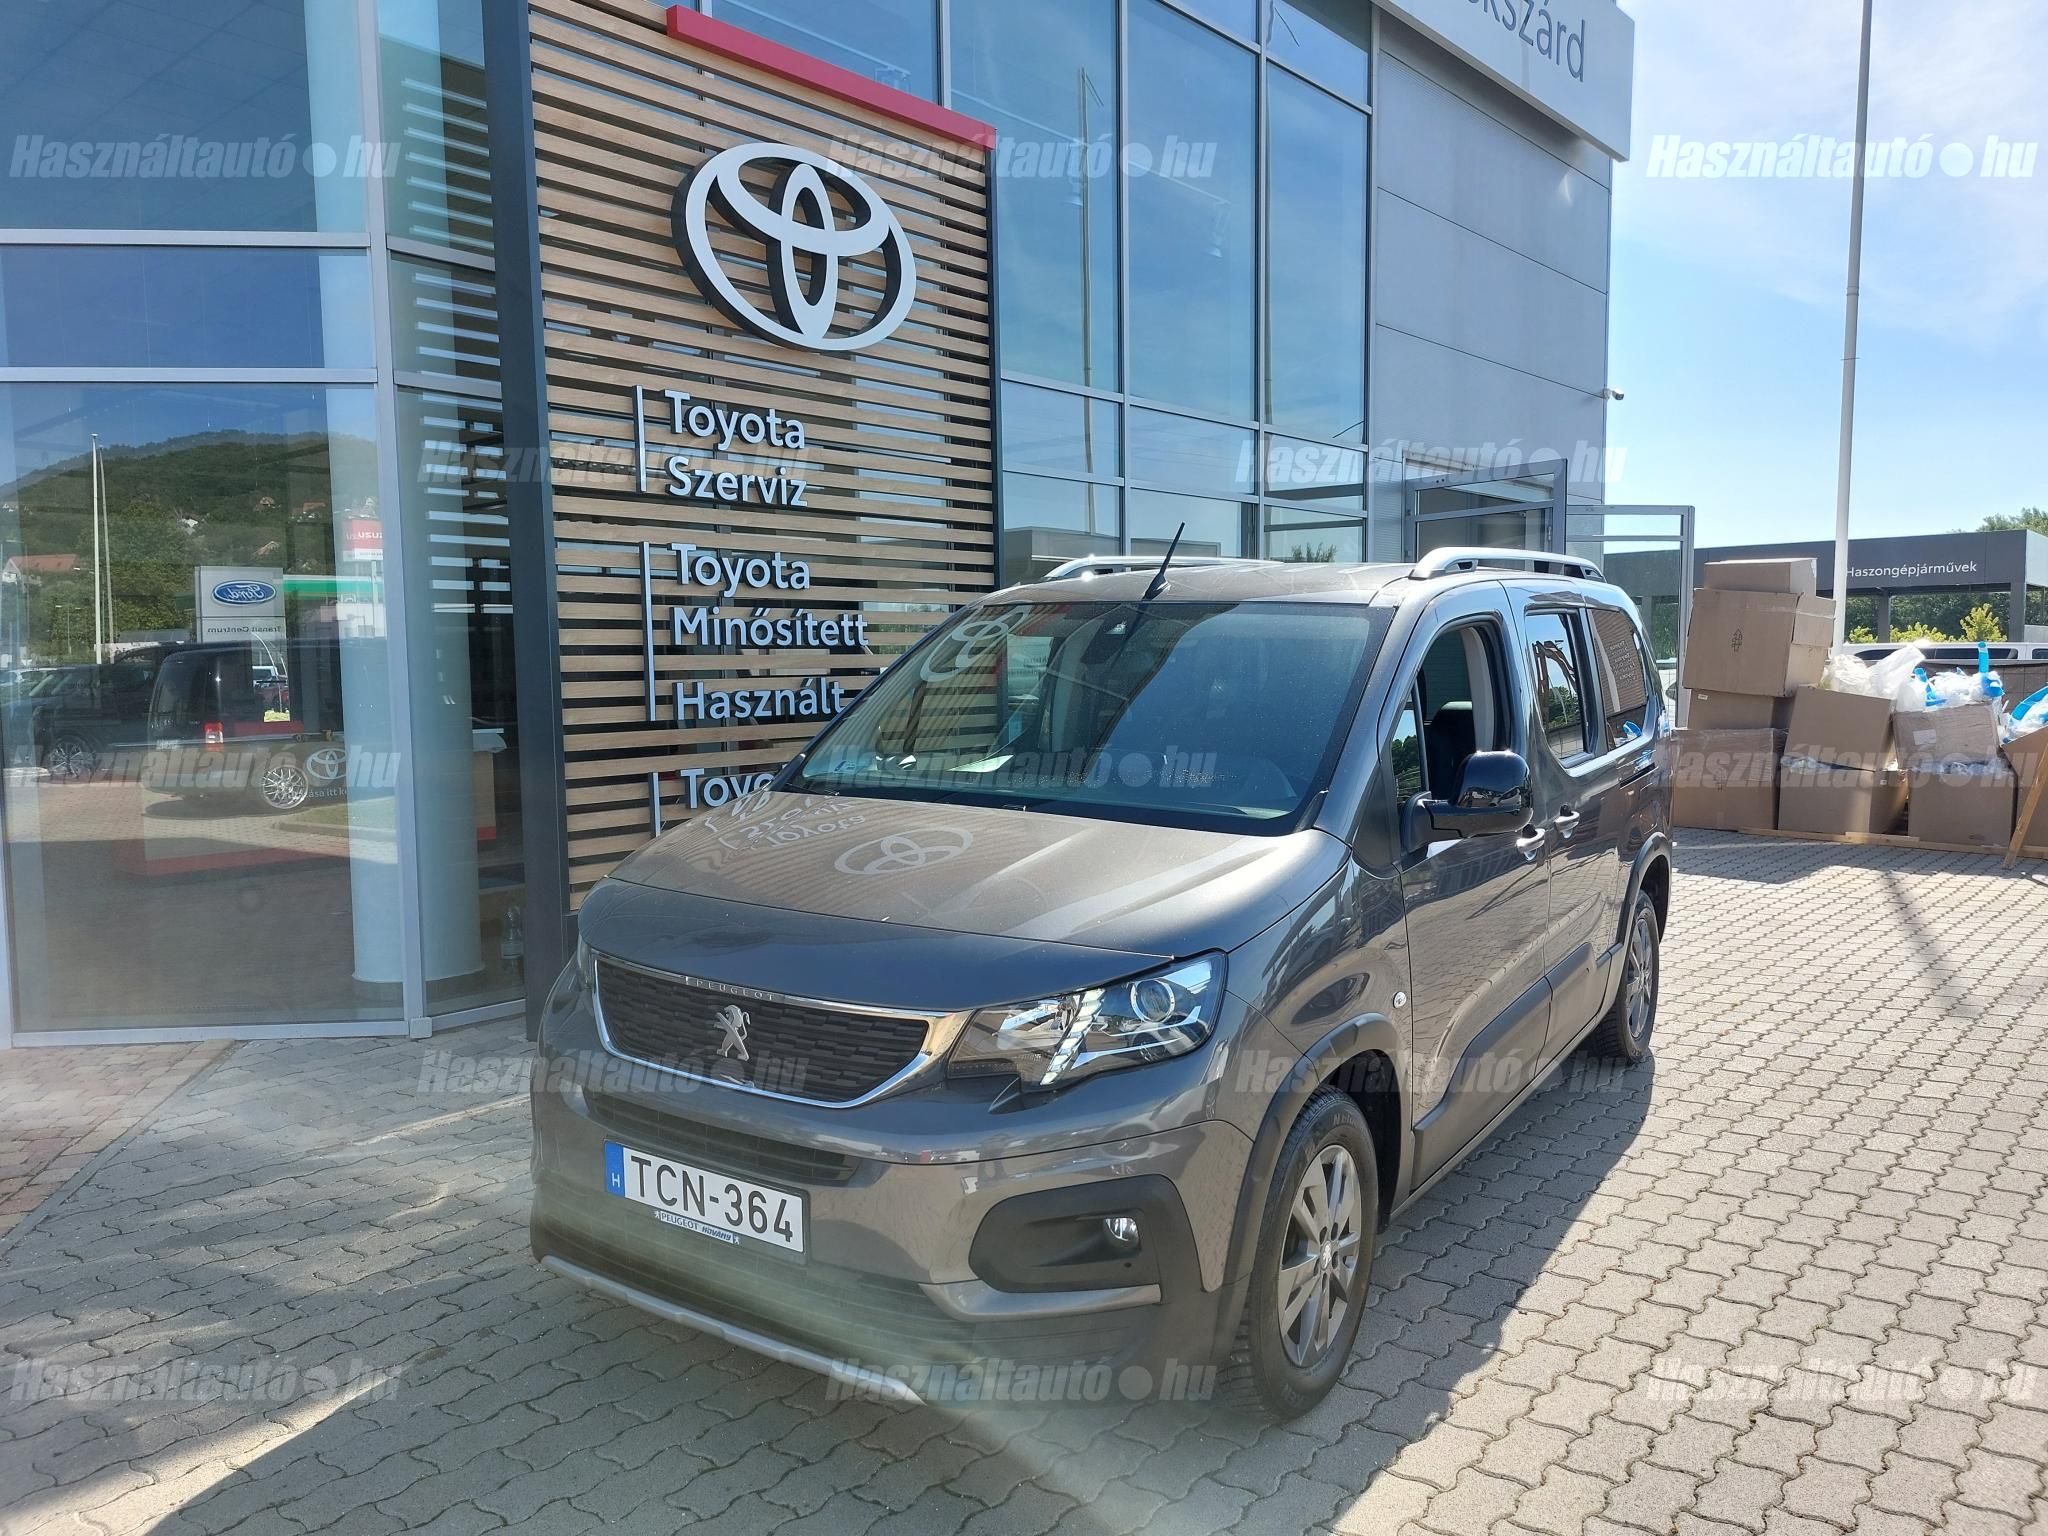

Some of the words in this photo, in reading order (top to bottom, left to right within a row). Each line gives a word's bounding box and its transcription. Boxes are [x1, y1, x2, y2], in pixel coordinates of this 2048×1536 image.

[664, 389, 805, 450] Toyota
[667, 455, 808, 506] Szerviz
[671, 543, 811, 598] Toyota
[1847, 560, 1977, 578] Haszongépjárművek
[672, 607, 869, 646] Minősített
[675, 678, 846, 721] Használt
[696, 979, 774, 1001] PEUGEOT
[611, 1172, 620, 1188] H
[631, 1155, 793, 1243] TCN-364
[661, 1212, 698, 1230] PEUGEOT
